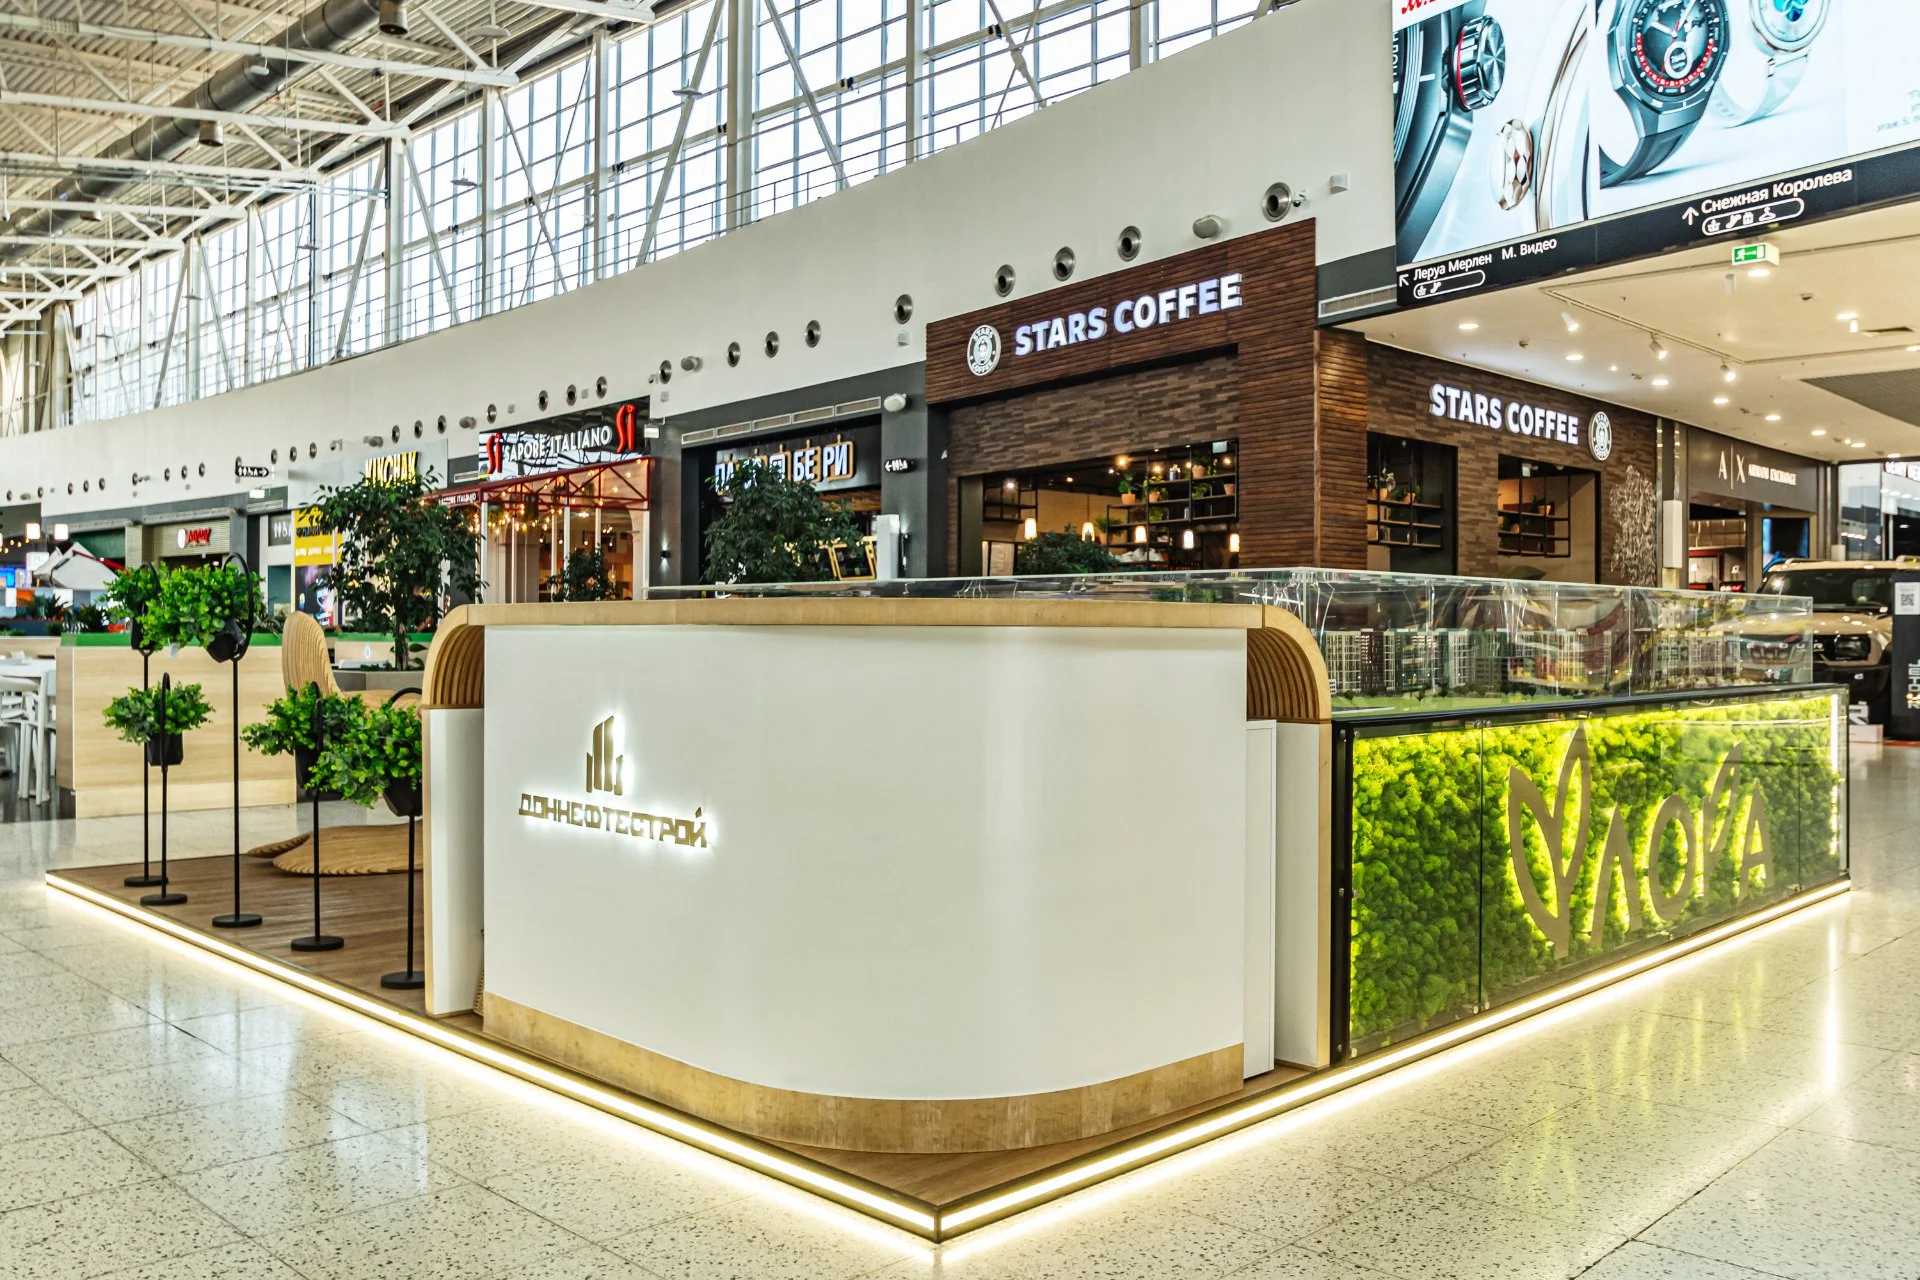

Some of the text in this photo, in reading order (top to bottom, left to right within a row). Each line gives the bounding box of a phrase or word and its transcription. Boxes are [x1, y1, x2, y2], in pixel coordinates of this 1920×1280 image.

[1701, 168, 1853, 214] Снежная Королева
[1413, 238, 1558, 282] Леруа Мерлен М. Видео
[1014, 272, 1243, 356] STARS COFFEE
[1429, 383, 1579, 445] STARS COFFEE
[504, 438, 547, 462] SAPORE
[550, 425, 613, 455] ITALIANO
[519, 793, 708, 848] ДОННЕФТЕСТРОЙ
